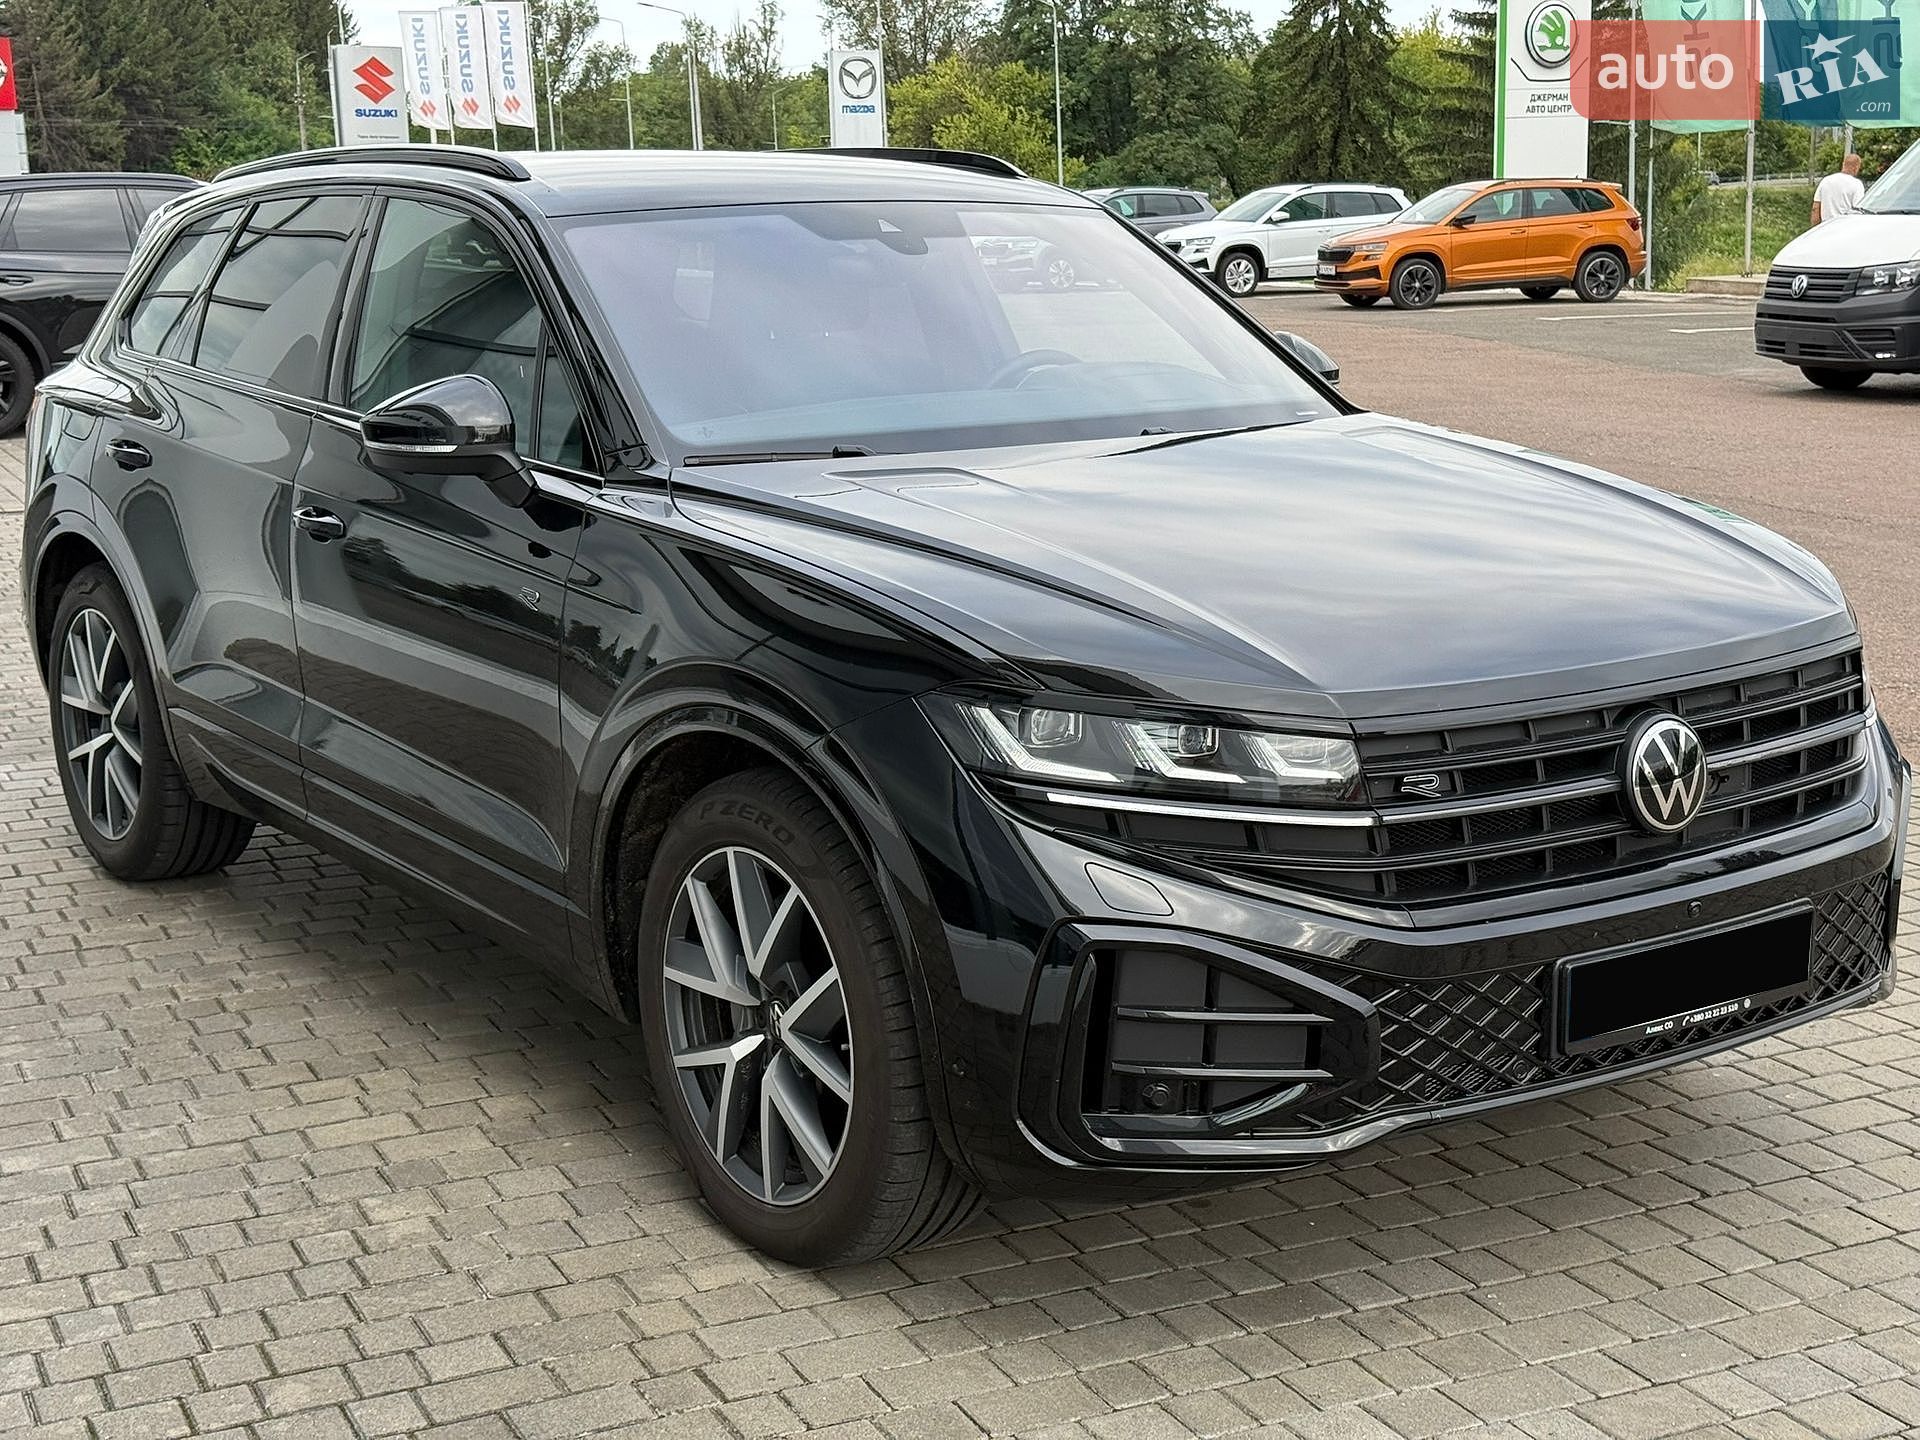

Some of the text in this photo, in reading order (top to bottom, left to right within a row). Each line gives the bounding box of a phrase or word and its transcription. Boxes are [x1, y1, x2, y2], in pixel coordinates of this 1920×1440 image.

[1529, 93, 1569, 103] ДЖЕРМАН
[355, 108, 398, 118] SUZUKI
[1525, 104, 1573, 114] АВТО ЦЕНТР
[1400, 773, 1442, 798] R
[700, 801, 796, 846] P ZERO
